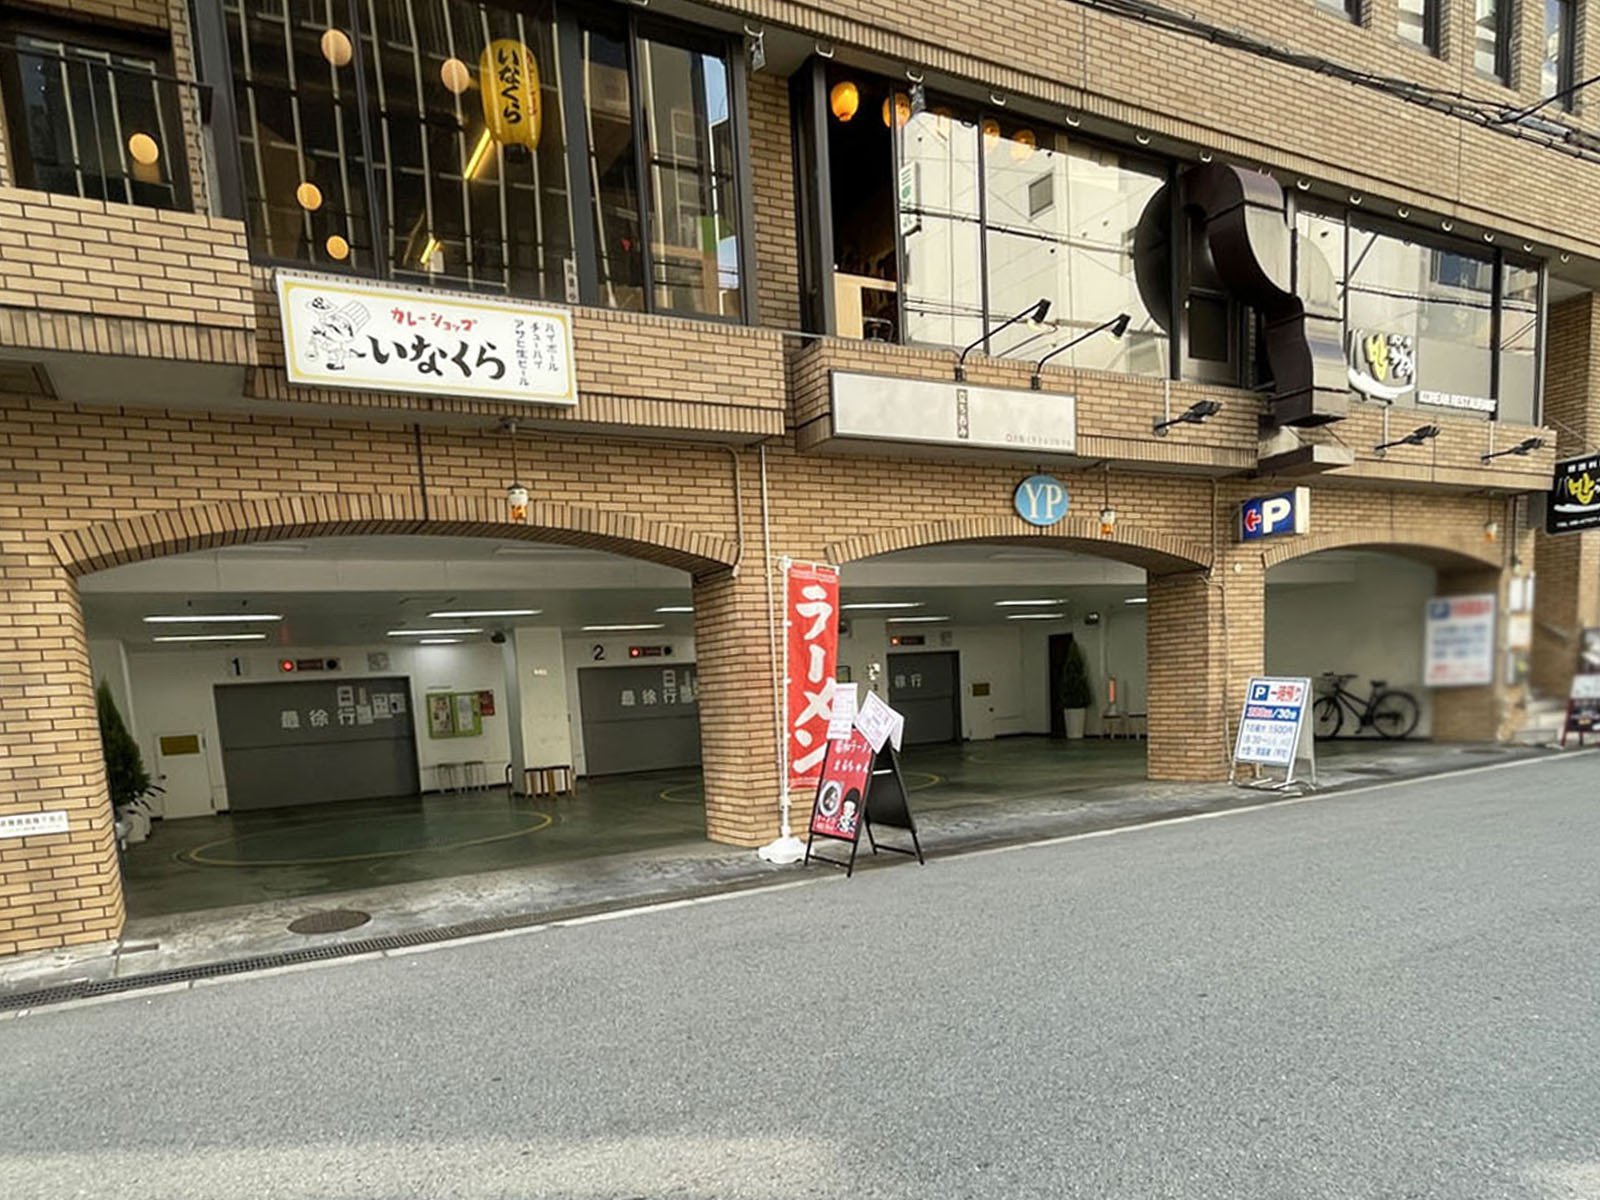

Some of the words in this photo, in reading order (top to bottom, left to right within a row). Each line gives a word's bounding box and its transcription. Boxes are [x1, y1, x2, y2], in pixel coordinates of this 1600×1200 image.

[498, 48, 522, 124] いなくら
[391, 307, 478, 332] カレーショップ
[367, 333, 507, 381] いなくら
[545, 322, 559, 372] ハイボール
[1025, 483, 1063, 519] YP
[1262, 498, 1291, 534] P
[232, 657, 241, 676] 1
[593, 644, 604, 660] 2
[793, 585, 837, 774] ラーメン
[1254, 686, 1267, 699] P
